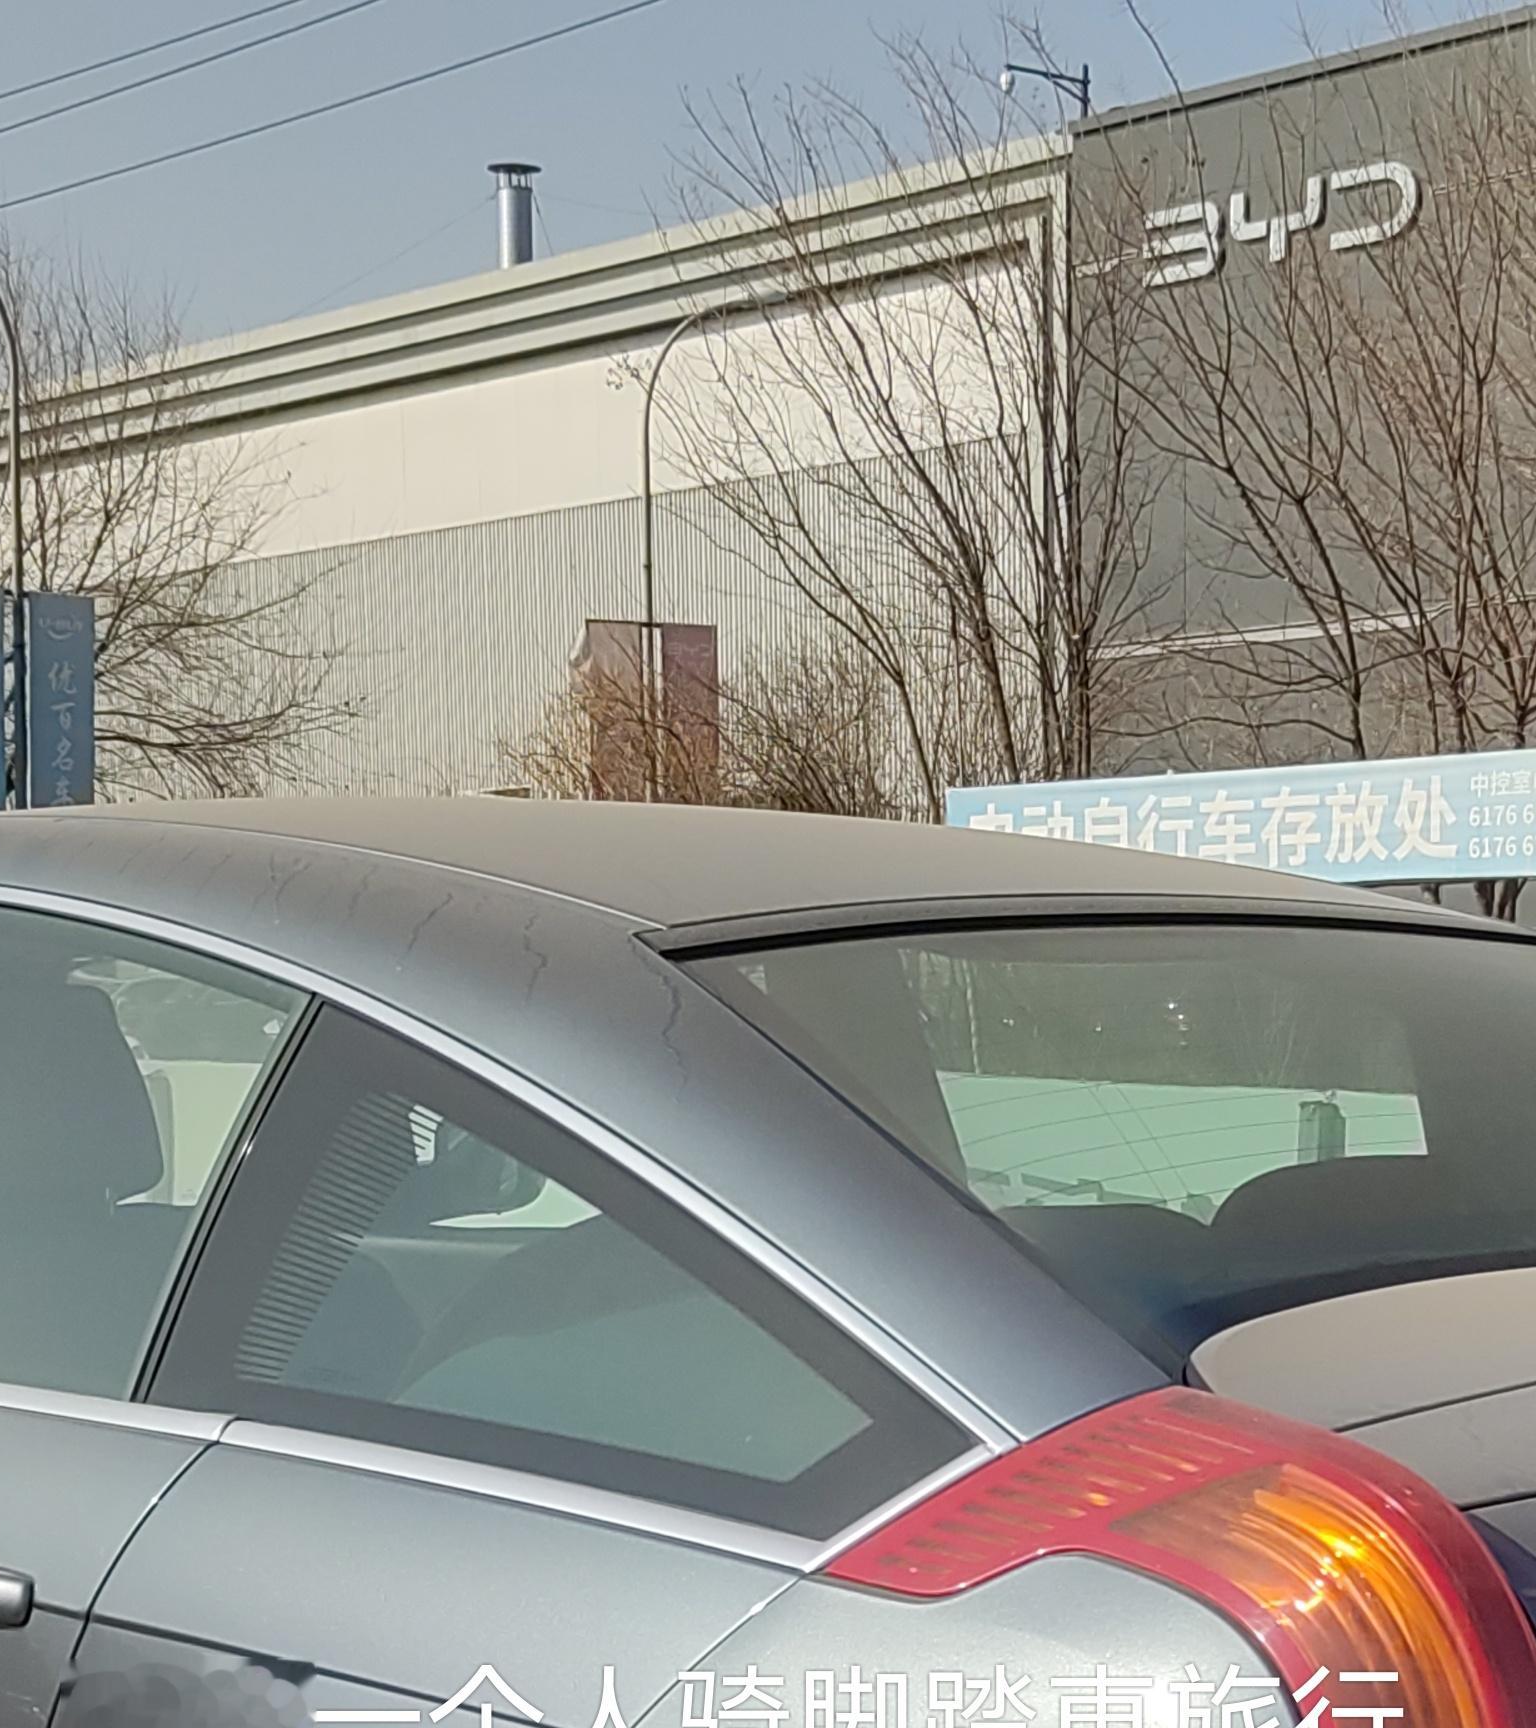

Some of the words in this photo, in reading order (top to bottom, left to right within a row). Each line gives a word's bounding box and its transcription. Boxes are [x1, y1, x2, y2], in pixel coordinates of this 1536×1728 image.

[1141, 161, 1421, 288] BYD
[1469, 805, 1517, 827] 6176
[1468, 836, 1516, 859] 6176
